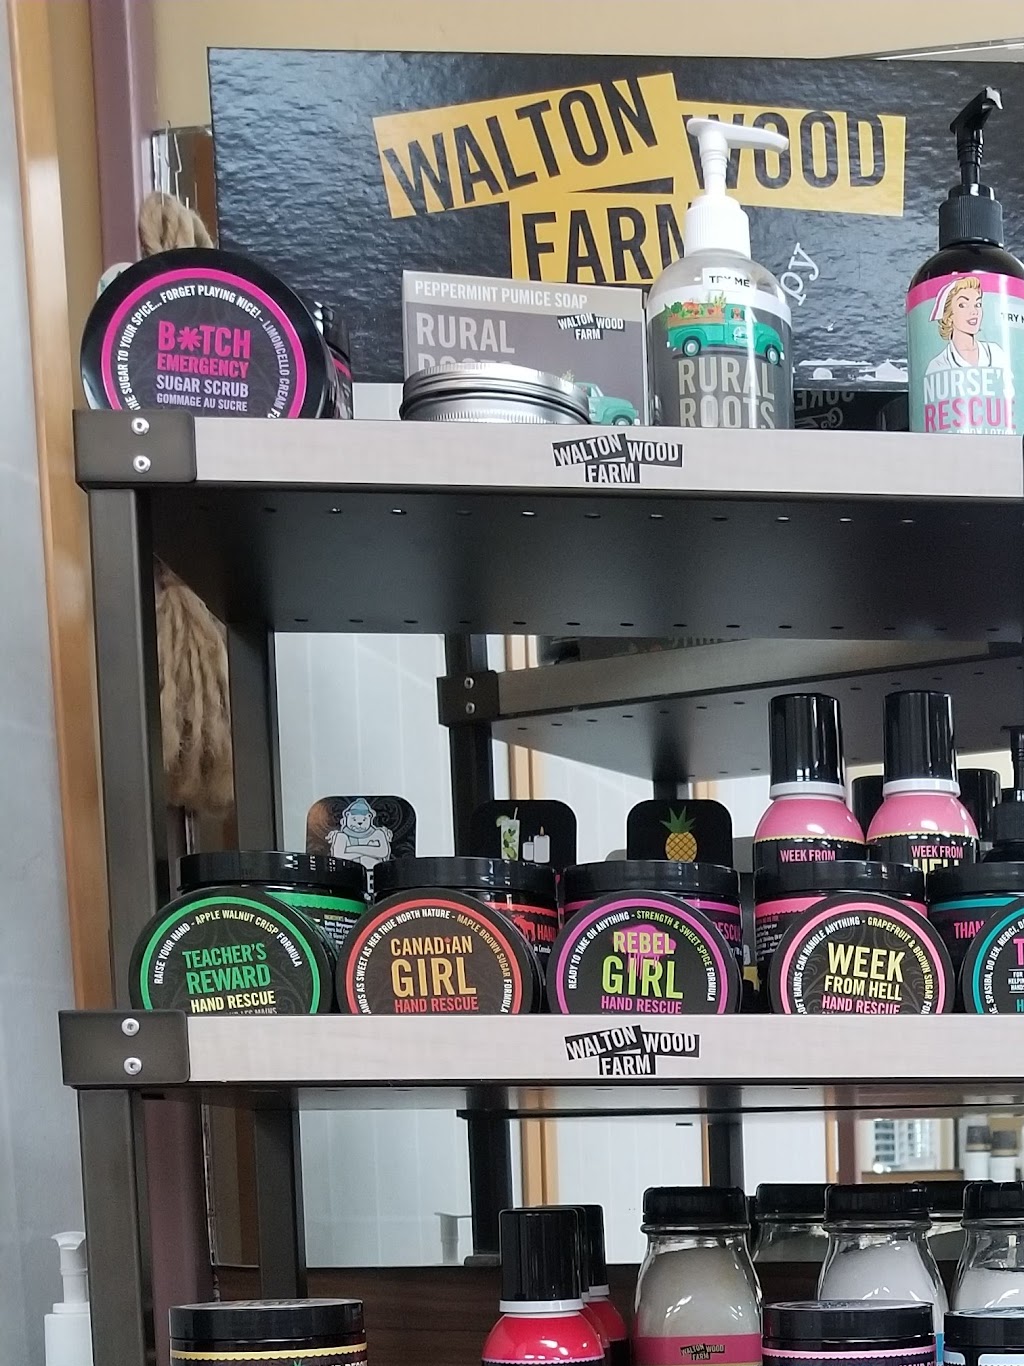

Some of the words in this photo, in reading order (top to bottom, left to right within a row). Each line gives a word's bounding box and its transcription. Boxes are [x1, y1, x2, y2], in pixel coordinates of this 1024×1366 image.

[382, 77, 659, 215] WALTON
[160, 285, 196, 303] FORGET
[197, 286, 235, 303] PLAYING
[415, 280, 498, 298] PEPPERMINT
[501, 287, 552, 306] PUMICE
[555, 292, 588, 309] SOAP
[236, 296, 262, 318] NICE!
[416, 312, 515, 354] RURAL
[558, 313, 593, 330] WALTON
[596, 317, 624, 330] WOOD
[575, 328, 600, 340] FARM
[120, 327, 138, 349] YOUR
[262, 320, 290, 375] LIMONCELLO
[118, 350, 129, 362] TO
[157, 353, 250, 379] EMERGENCY
[118, 364, 135, 394] SUGAR
[156, 375, 201, 393] SUGAR
[204, 379, 249, 398] SCRUB
[678, 356, 775, 400] RURAL
[273, 378, 290, 411] CREAM
[554, 435, 622, 466] WALTON
[627, 442, 679, 462] WOOD
[588, 463, 635, 483] FARM
[780, 850, 807, 862] WEEK
[809, 850, 835, 861] FROM
[912, 846, 938, 858] WEEK
[940, 846, 963, 859] FROM
[614, 931, 675, 955] REBEL
[182, 943, 267, 969] TEACHER'S
[828, 942, 905, 983] WEEK
[186, 964, 271, 995] REWARD
[391, 957, 476, 998] GIRL
[603, 956, 683, 999] GIRL
[824, 975, 865, 997] FROM
[869, 981, 902, 1001] HELL
[191, 997, 225, 1013] HAND
[228, 991, 276, 1009] RESCUE
[395, 999, 427, 1013] HAND
[431, 997, 479, 1012] RESCUE
[602, 996, 632, 1011] HAND
[636, 1000, 682, 1014] RESCUE
[566, 1026, 637, 1060] WALTON
[642, 1033, 696, 1053] WOOD
[601, 1054, 651, 1075] FARM
